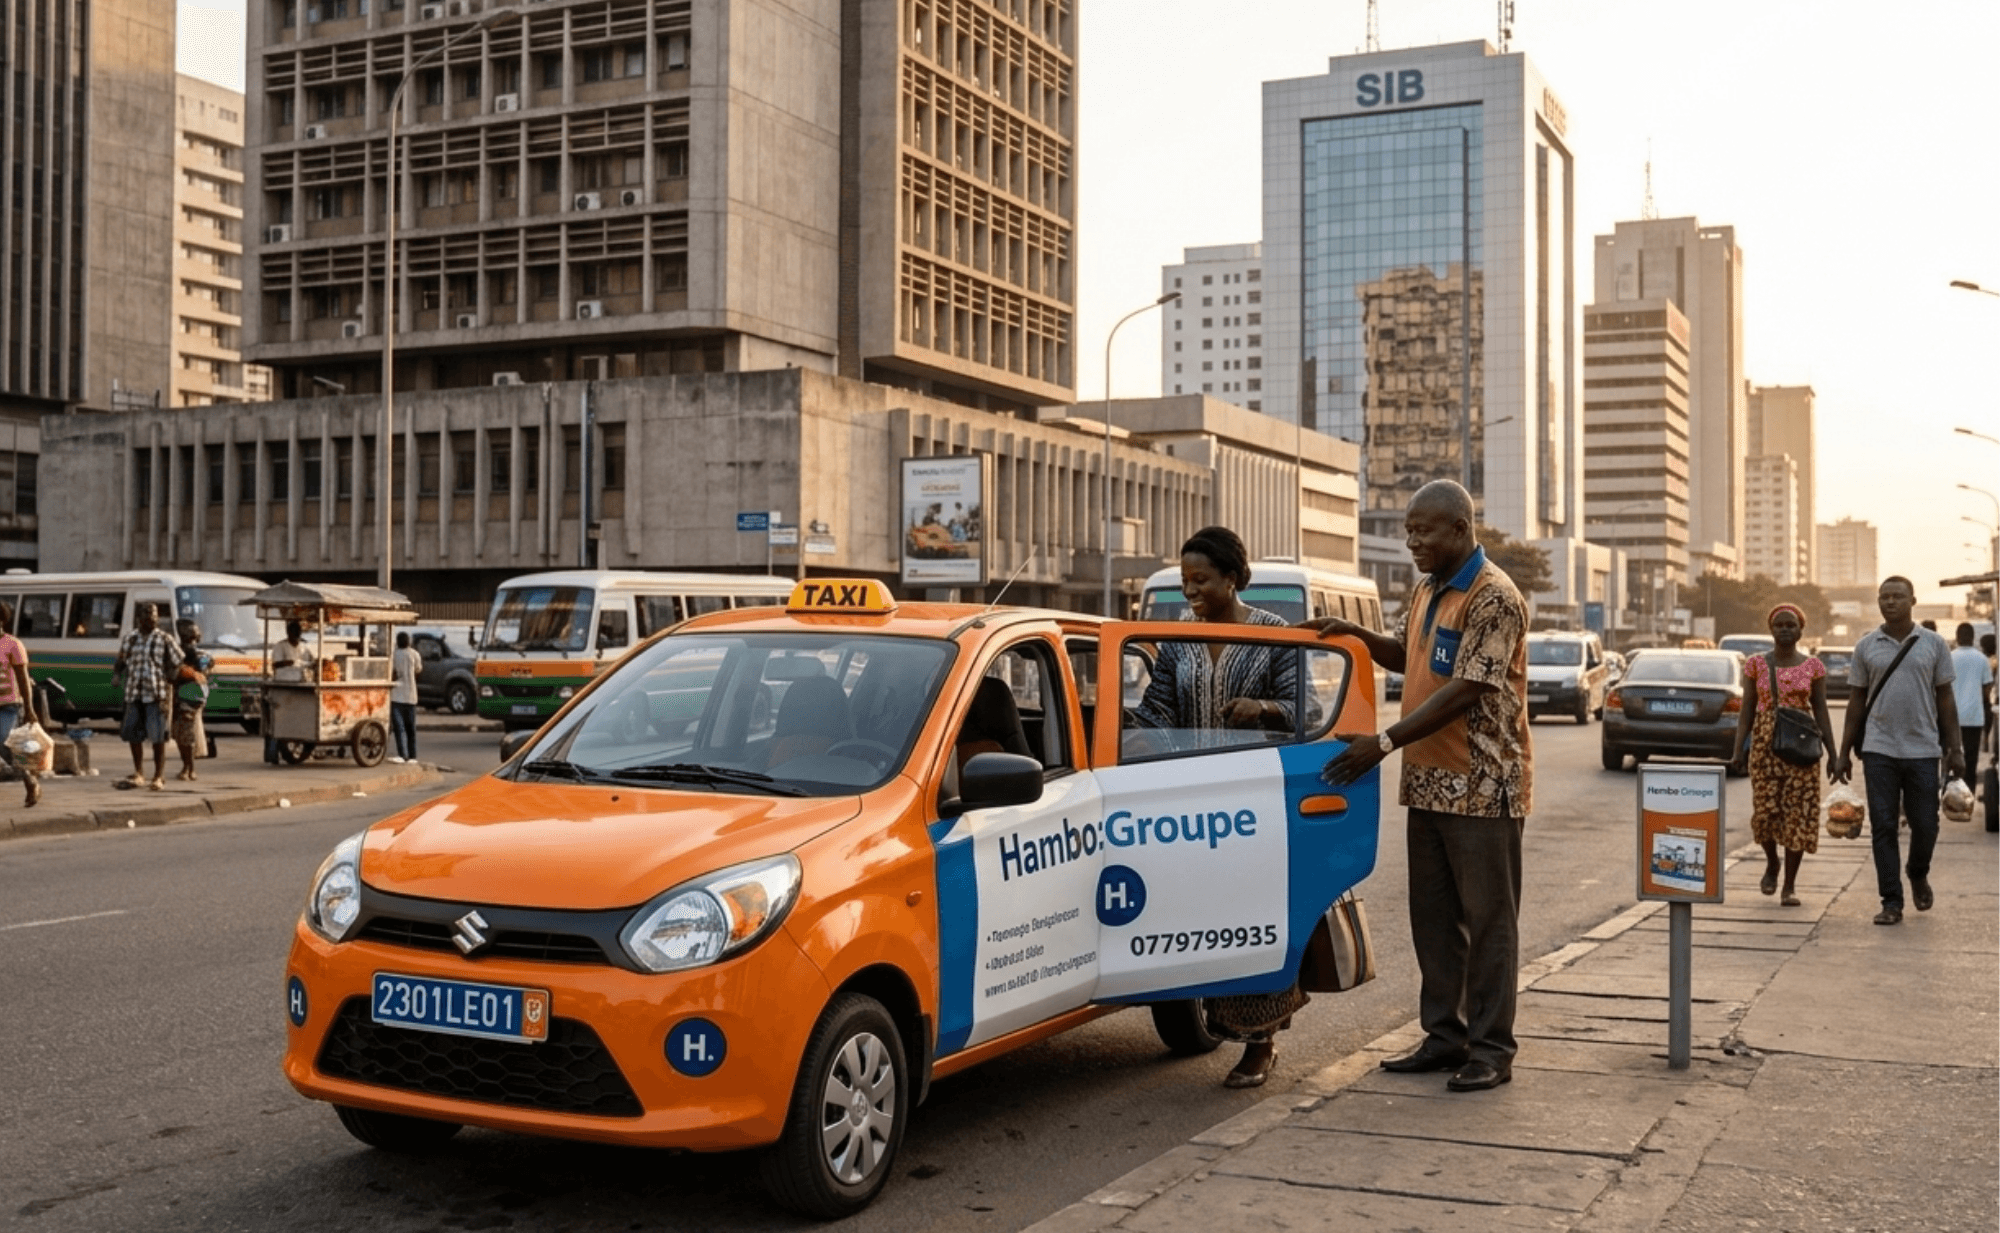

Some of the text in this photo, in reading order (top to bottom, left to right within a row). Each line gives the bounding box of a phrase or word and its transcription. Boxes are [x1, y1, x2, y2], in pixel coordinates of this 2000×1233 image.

[1356, 69, 1425, 107] SIB
[803, 584, 868, 606] TAXI
[1104, 882, 1136, 910] H.
[1130, 924, 1278, 957] 0779799935
[378, 980, 513, 1030] 2301LE01
[683, 1033, 714, 1062] H.
